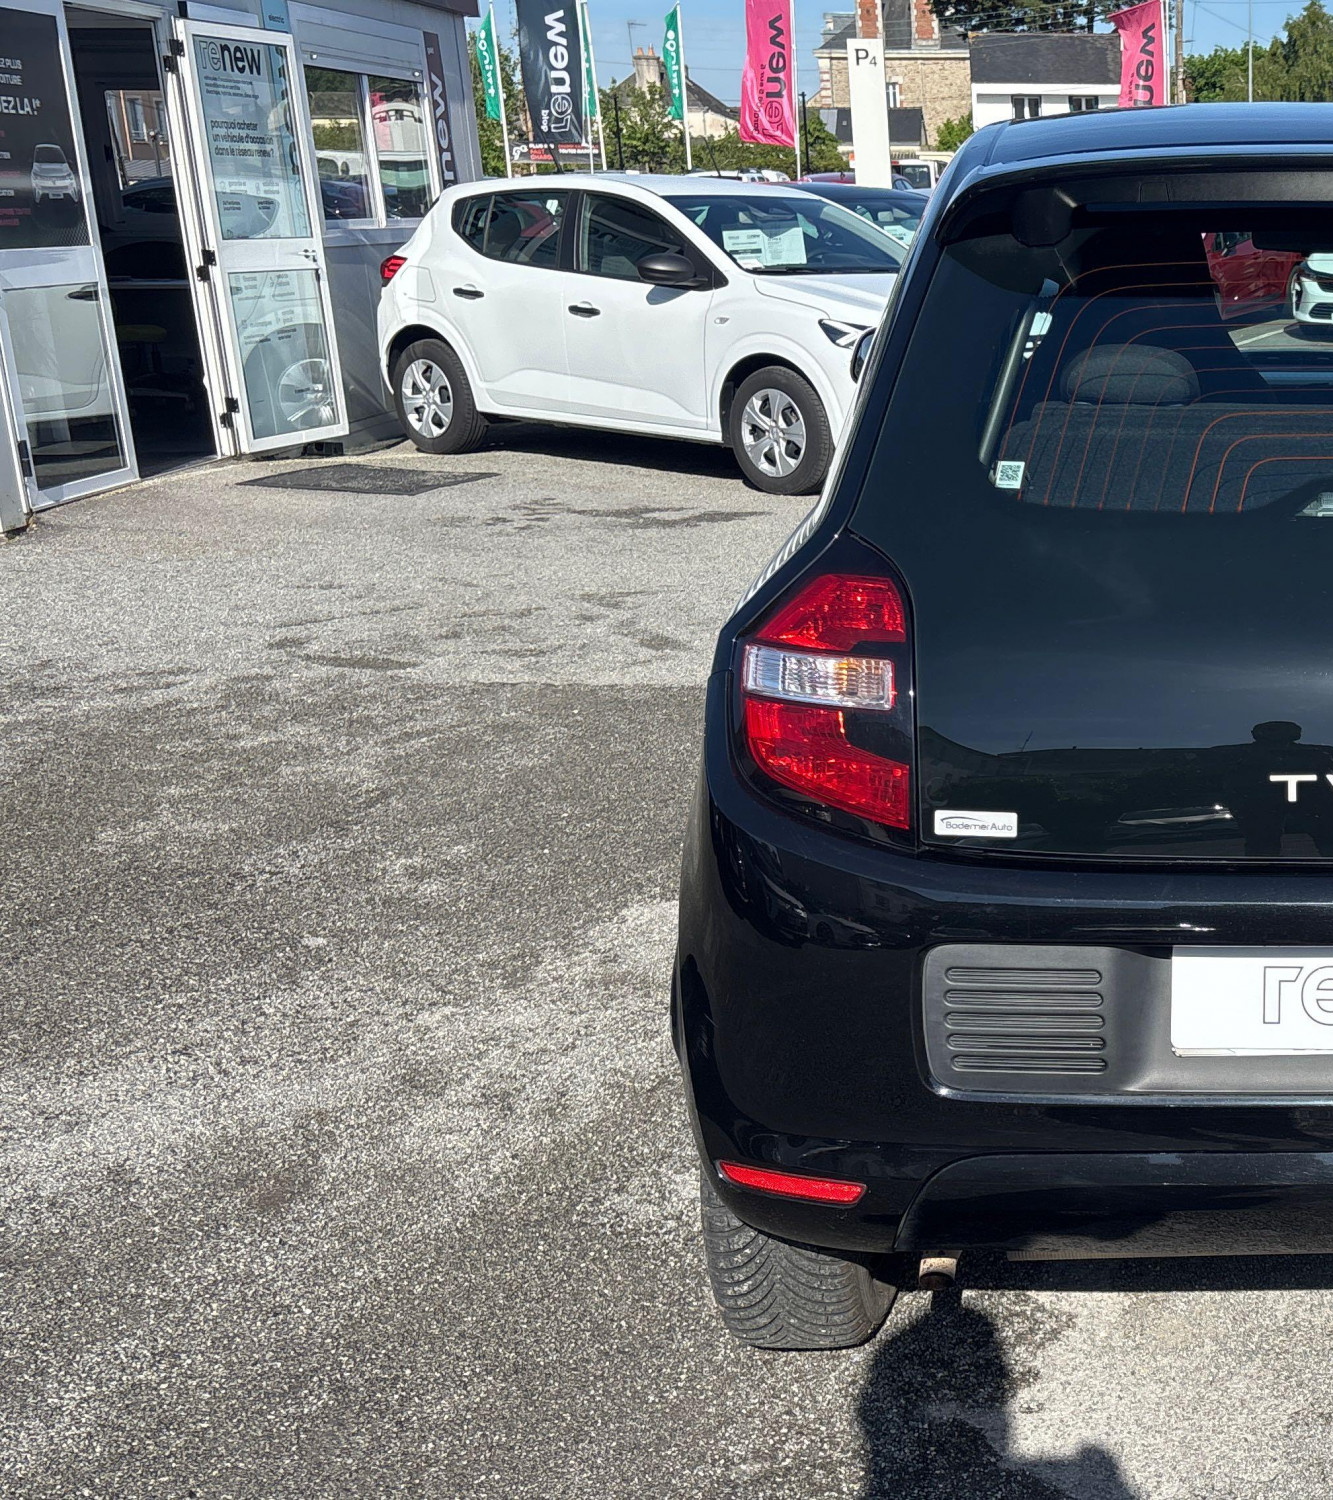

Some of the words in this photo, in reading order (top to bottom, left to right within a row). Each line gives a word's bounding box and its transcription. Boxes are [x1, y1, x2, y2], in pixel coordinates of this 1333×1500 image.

[199, 40, 262, 76] renew
[16, 97, 33, 115] LA
[210, 119, 236, 132] pourquoi
[236, 120, 258, 131] acheter
[430, 71, 456, 189] new
[212, 133, 221, 142] un
[214, 145, 229, 156] dans
[229, 145, 235, 156] le
